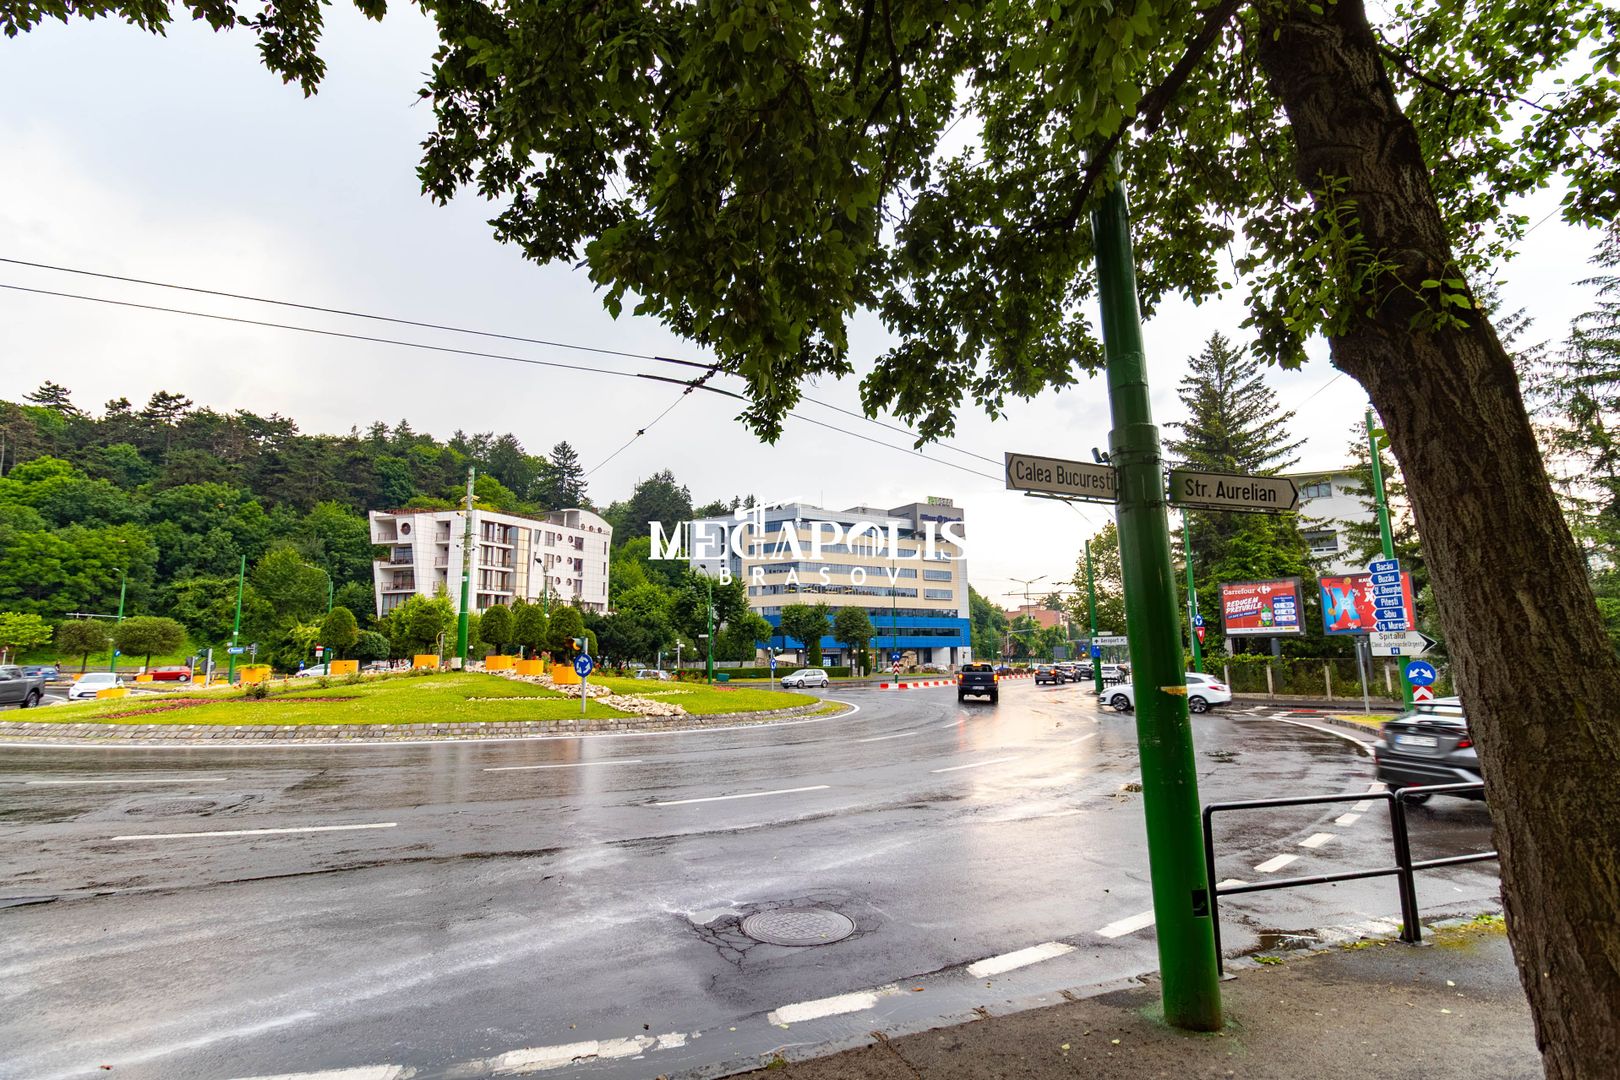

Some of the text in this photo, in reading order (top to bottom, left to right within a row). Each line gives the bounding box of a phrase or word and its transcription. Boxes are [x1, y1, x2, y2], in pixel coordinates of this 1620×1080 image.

[1016, 460, 1052, 484] Calea
[1185, 478, 1276, 503] Str. Aurelian
[1223, 587, 1256, 595] Carrefour
[1384, 610, 1397, 618] Sibiu
[1379, 622, 1388, 631] Tg.
[1379, 632, 1406, 641] Spitalul
